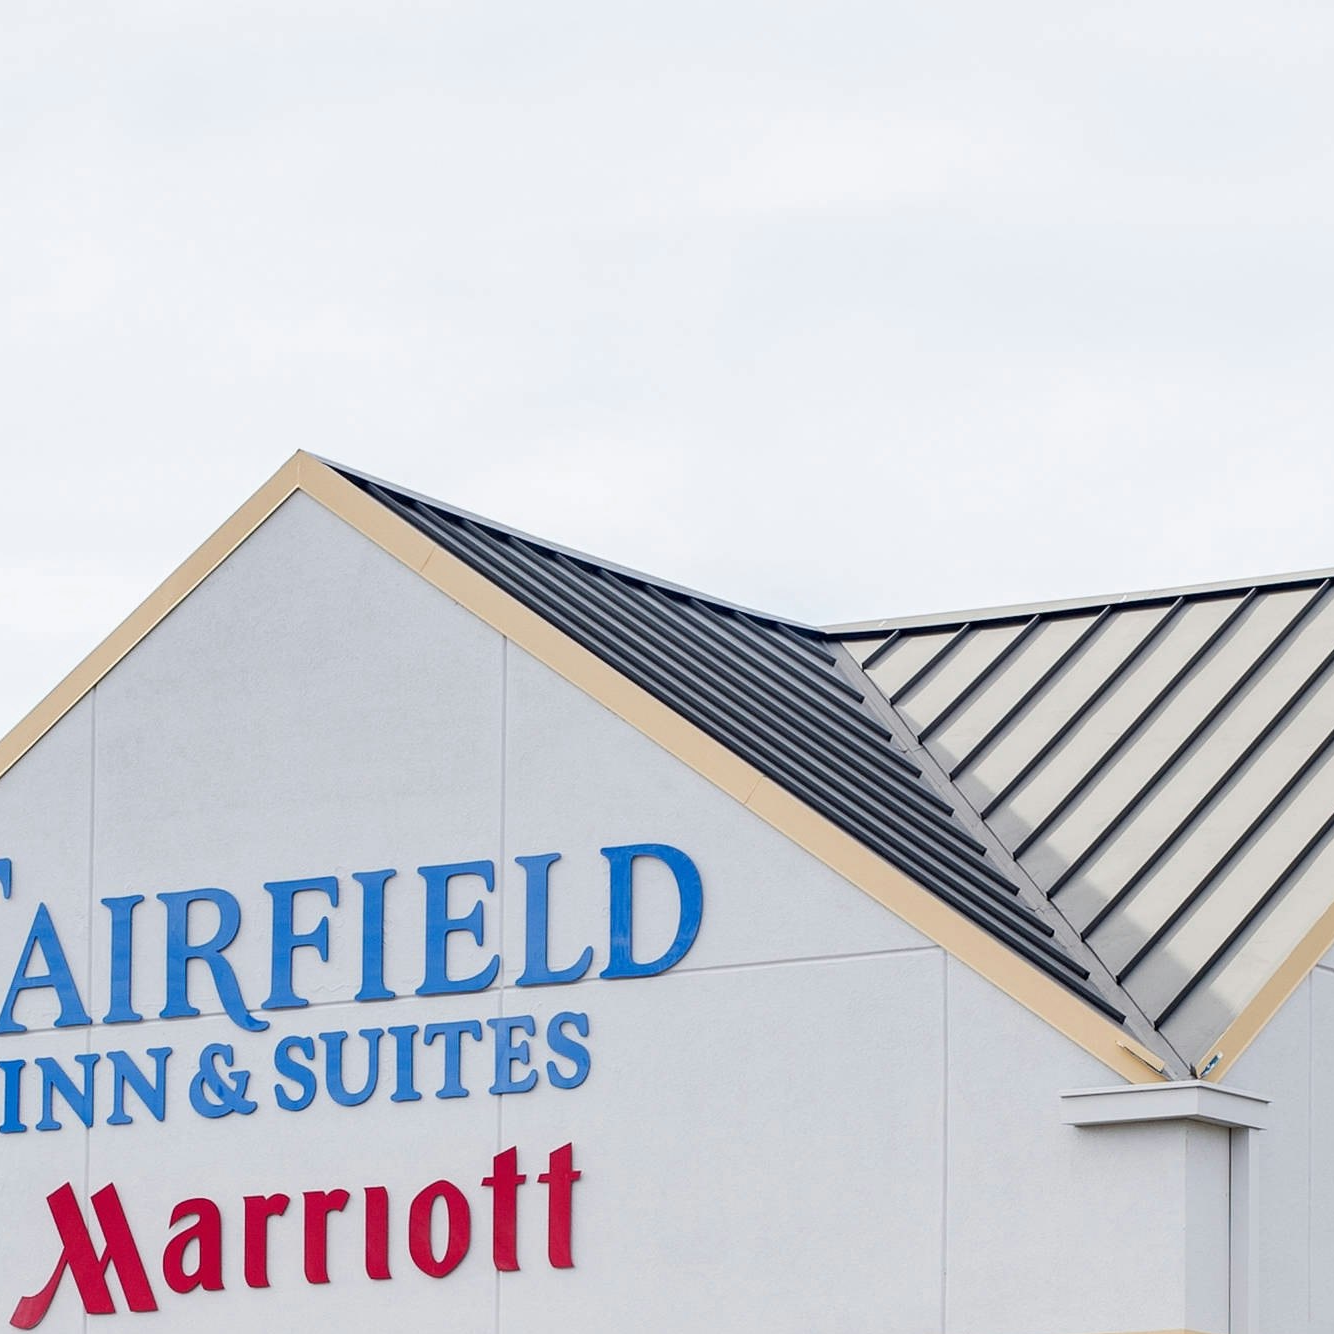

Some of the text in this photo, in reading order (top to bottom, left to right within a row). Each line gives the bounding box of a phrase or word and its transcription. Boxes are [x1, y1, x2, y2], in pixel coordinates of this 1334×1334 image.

[188, 1042, 258, 1119] &
[273, 1011, 591, 1112] SUITES
[9, 1142, 583, 1330] Marriott
